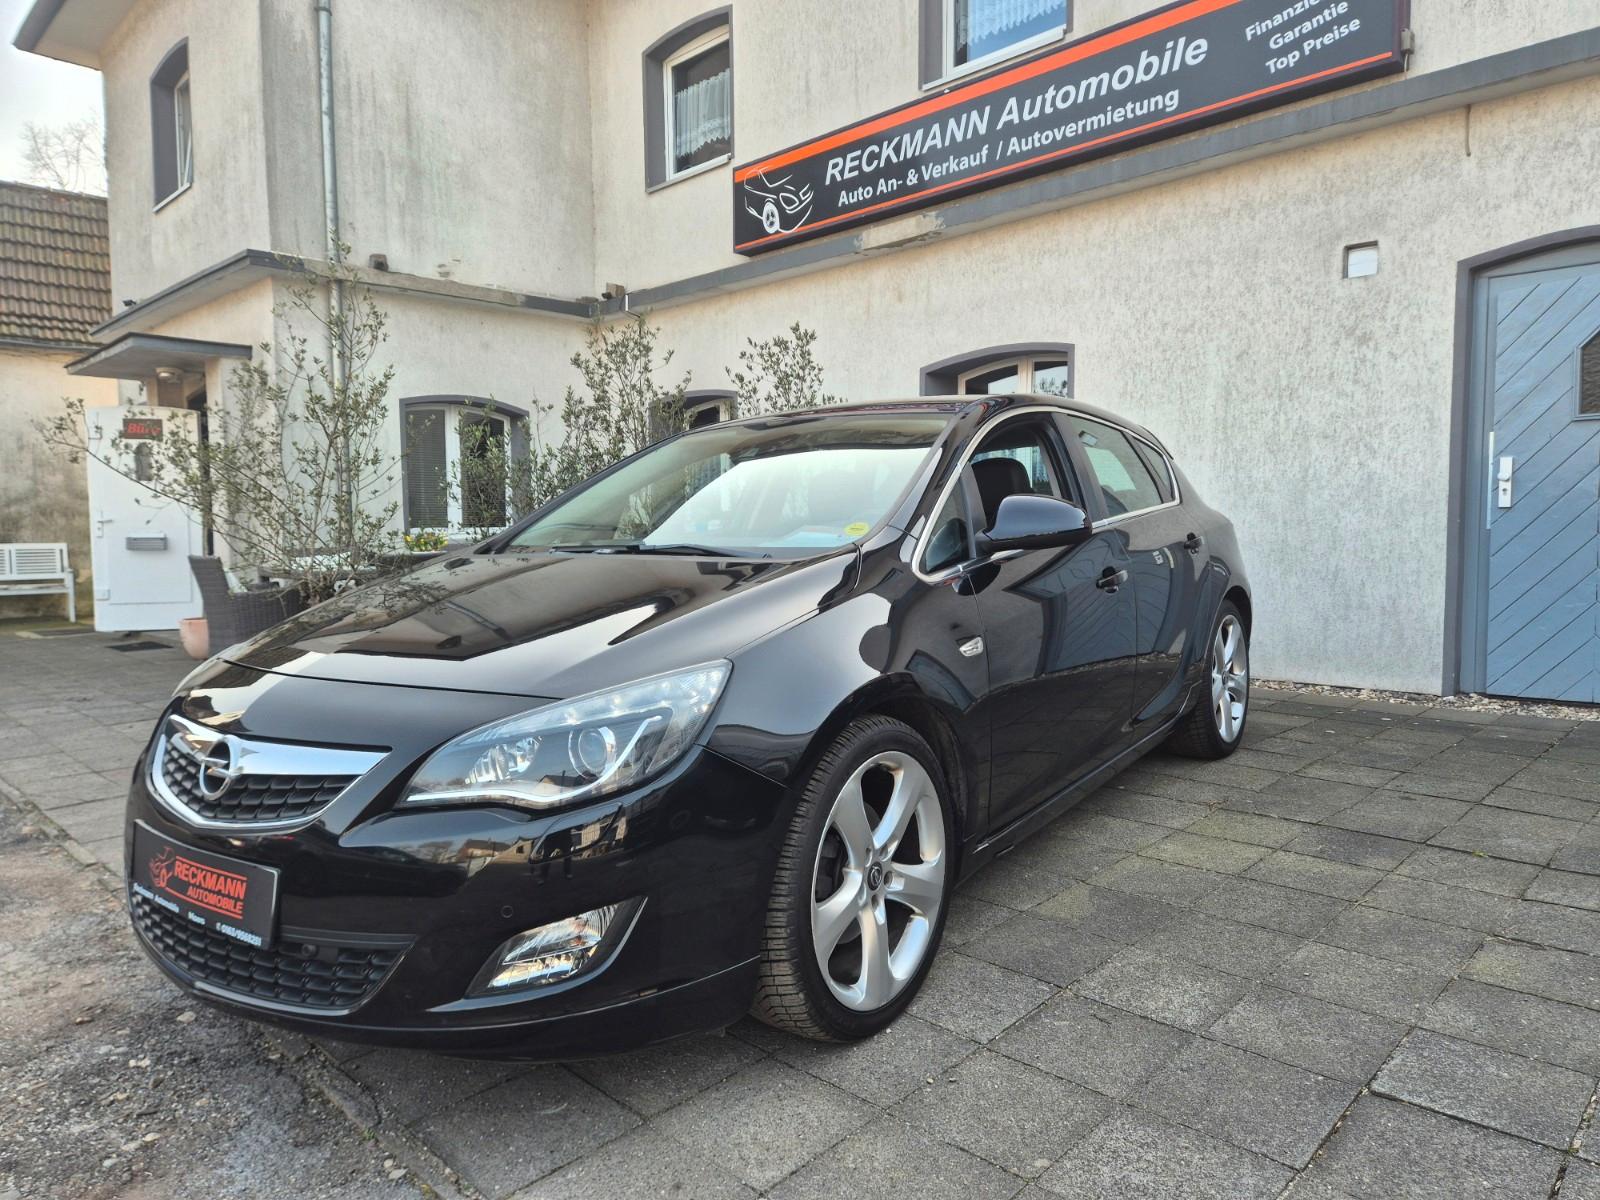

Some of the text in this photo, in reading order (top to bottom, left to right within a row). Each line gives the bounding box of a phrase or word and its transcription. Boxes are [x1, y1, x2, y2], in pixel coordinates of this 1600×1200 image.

[1265, 18, 1361, 74] Top Preise
[1269, 1, 1349, 49] Garantie
[825, 36, 1208, 185] RECKMANN Automobile
[838, 185, 873, 207] Auto
[876, 178, 903, 195] An-
[906, 168, 919, 186] &
[921, 144, 989, 181] Verkauf
[1006, 89, 1180, 156] Autovermietung
[174, 860, 247, 900] RECKMANN
[187, 886, 244, 914] AUTOMOBILE
